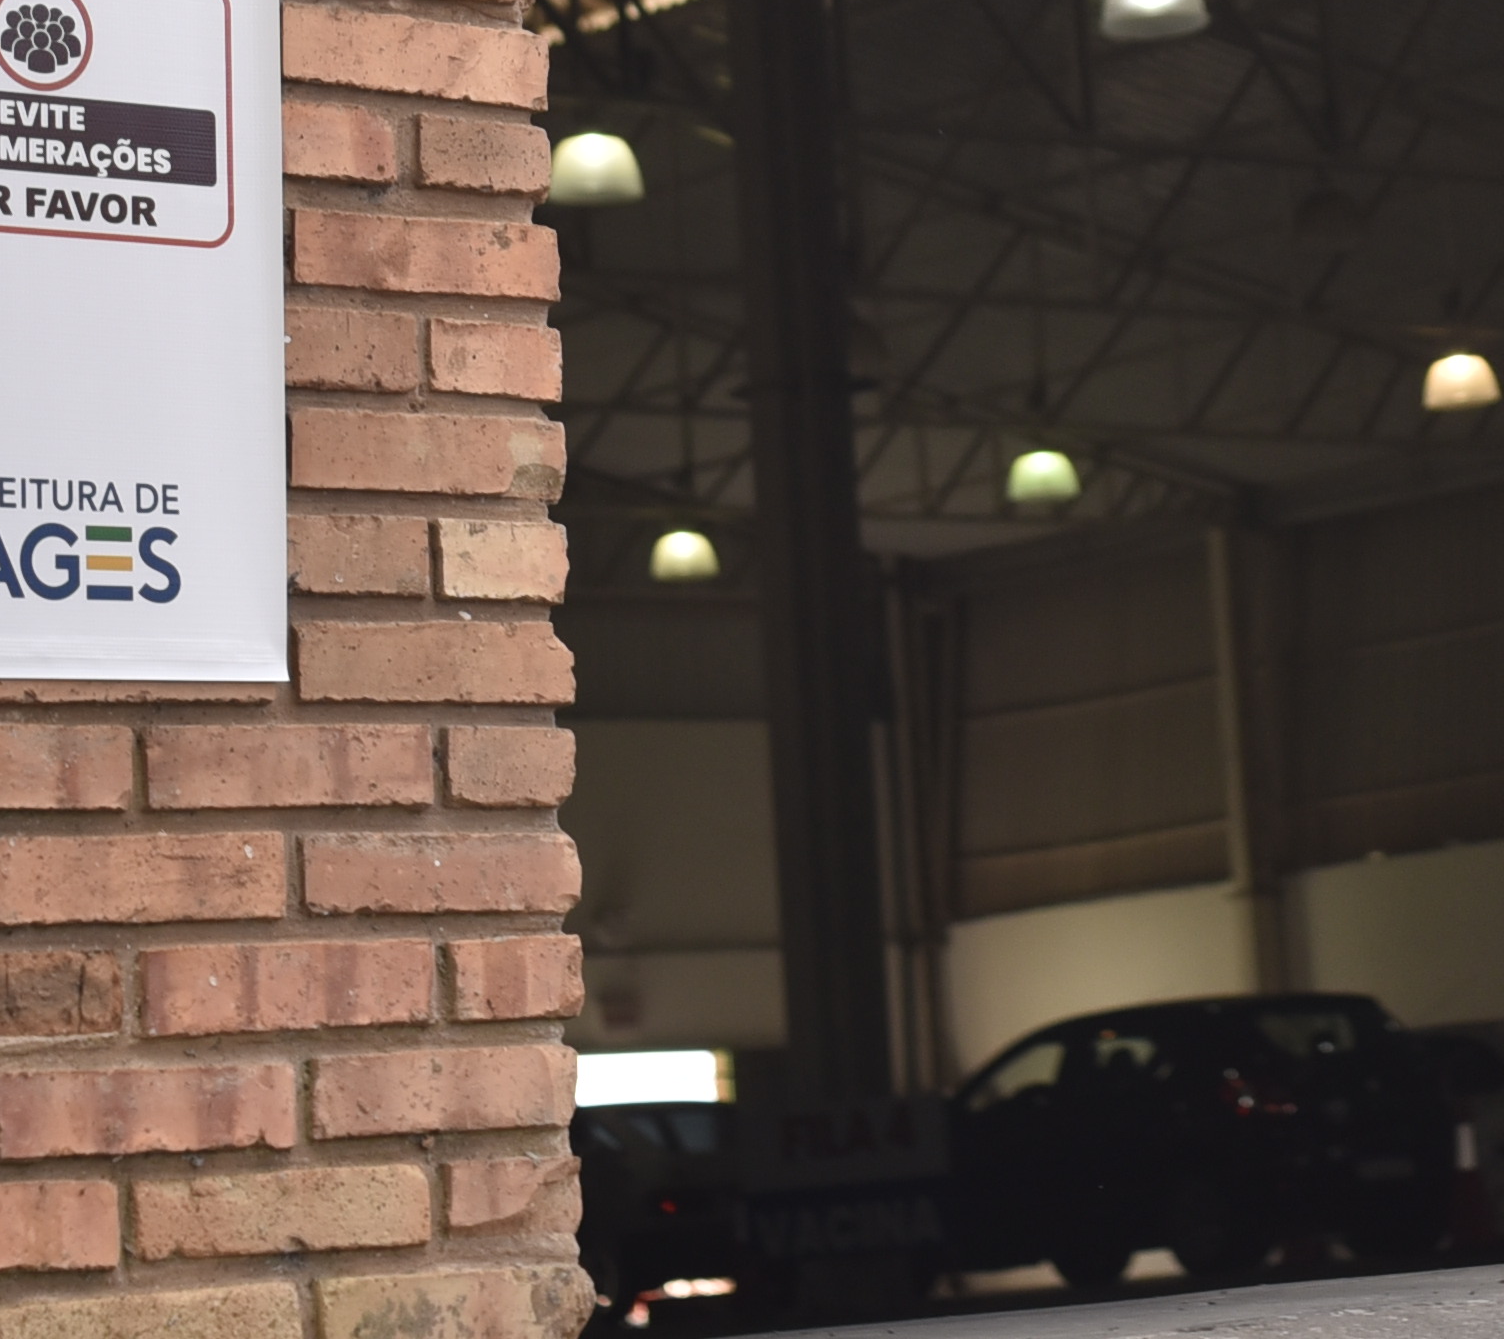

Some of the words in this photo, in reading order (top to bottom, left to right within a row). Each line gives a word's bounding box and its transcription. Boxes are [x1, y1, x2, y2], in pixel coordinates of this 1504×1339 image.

[0, 99, 86, 132] EVITE
[25, 187, 158, 227] FAVOR
[136, 483, 180, 515] DE
